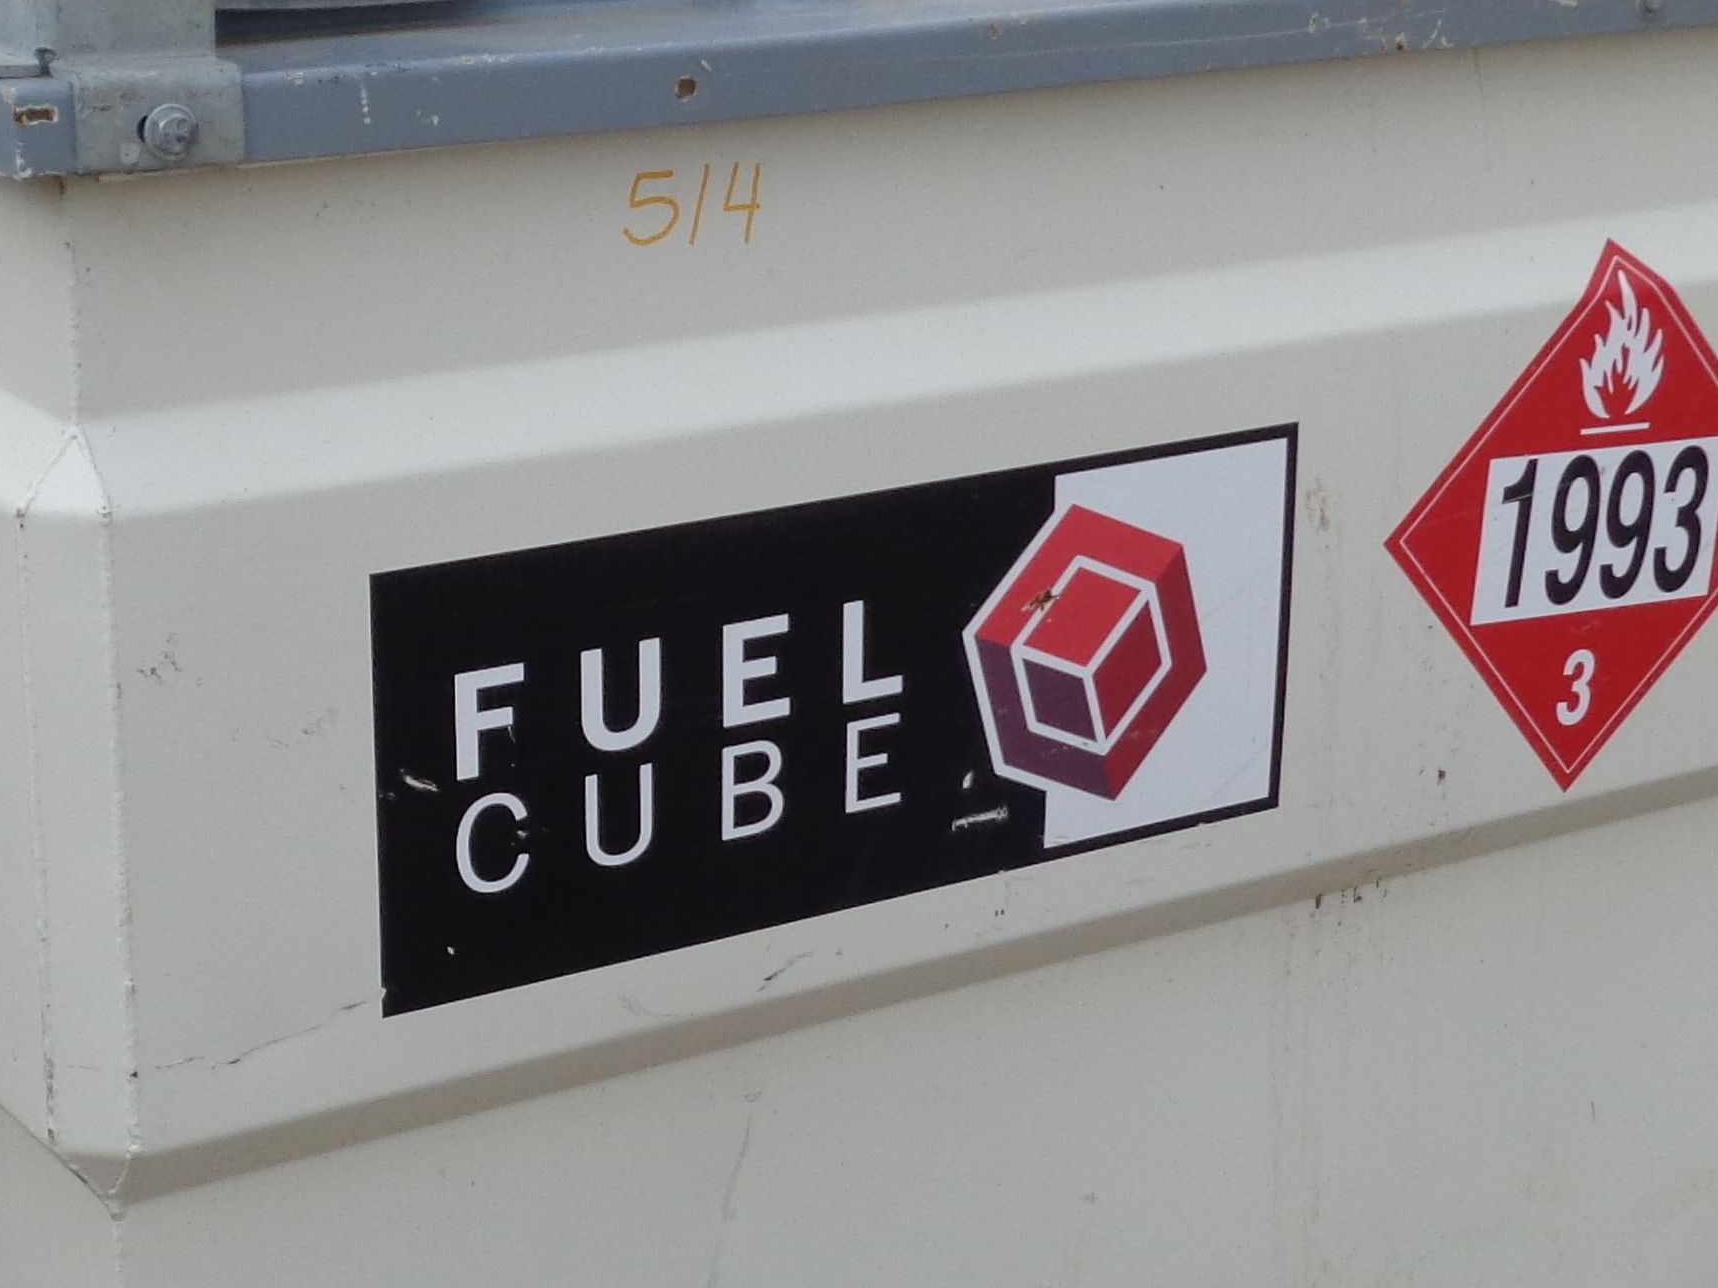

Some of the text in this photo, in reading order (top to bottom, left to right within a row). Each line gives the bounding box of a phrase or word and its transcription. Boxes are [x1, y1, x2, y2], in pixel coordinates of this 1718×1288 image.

[1500, 444, 1711, 609] 1993
[453, 599, 904, 783] FUEL
[1555, 648, 1596, 727] 3
[454, 711, 902, 894] CUBE
